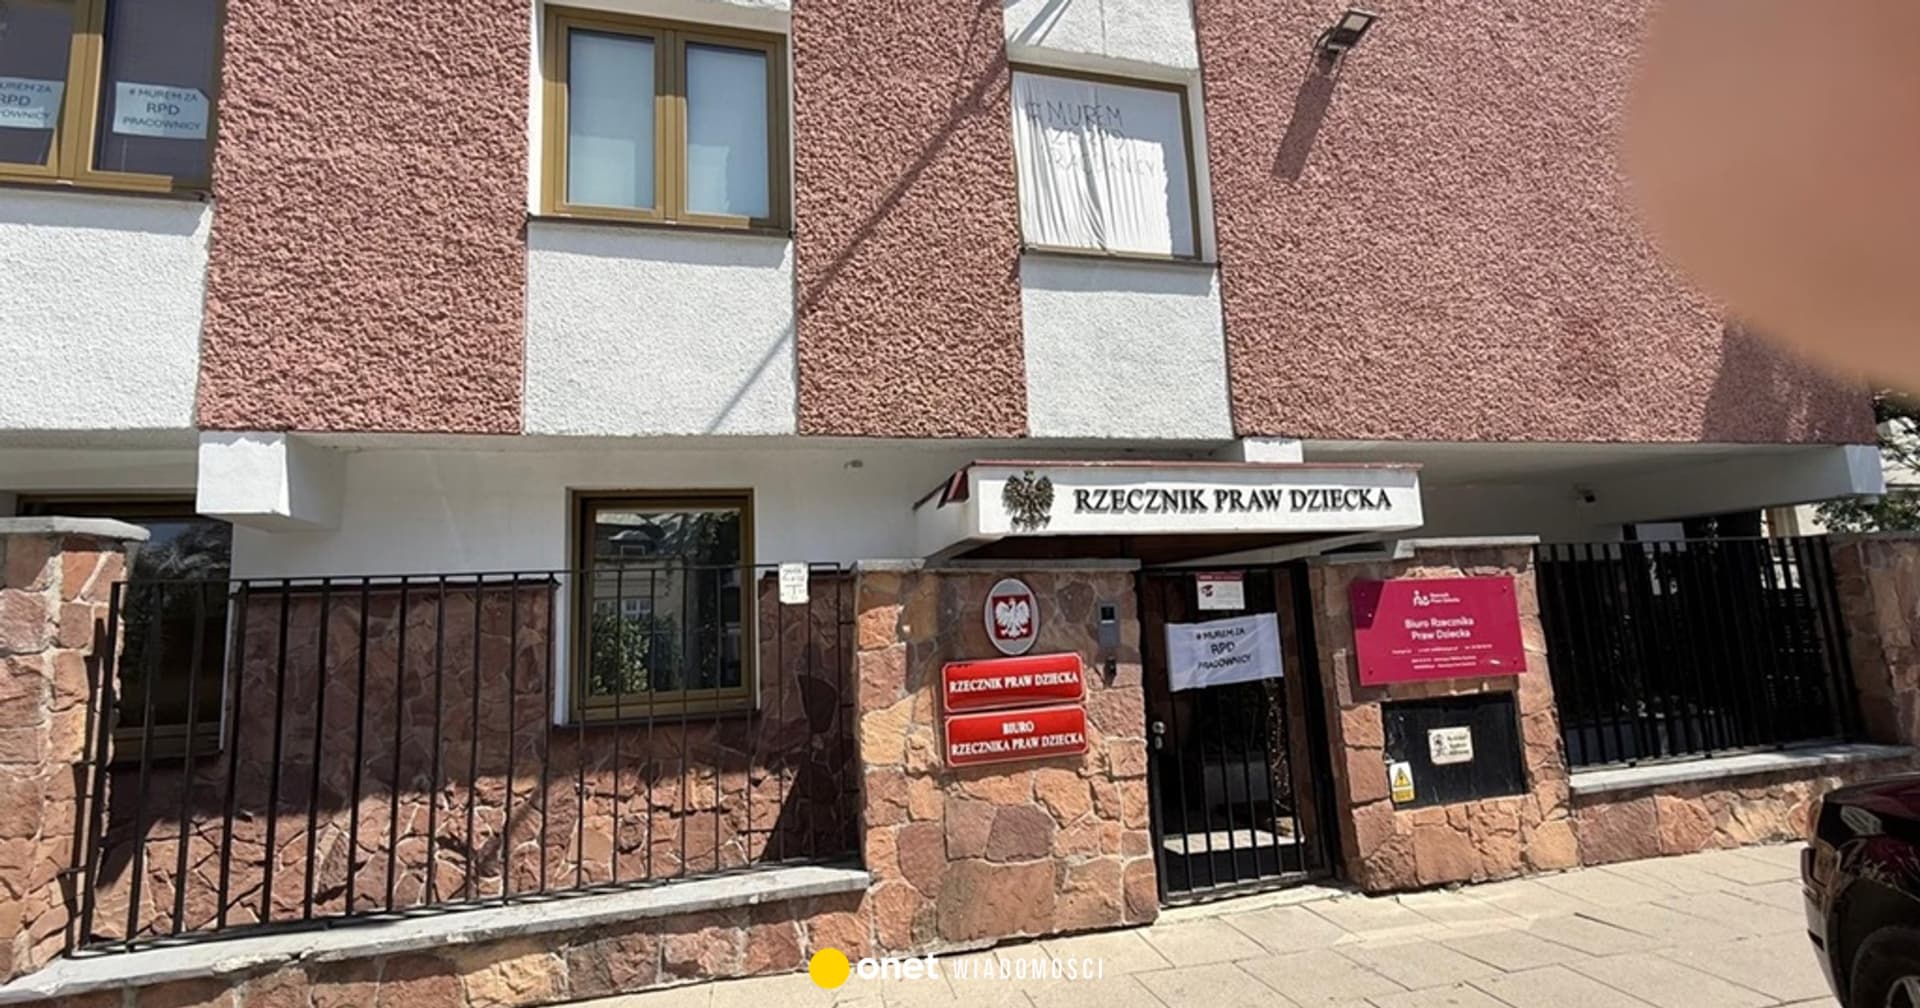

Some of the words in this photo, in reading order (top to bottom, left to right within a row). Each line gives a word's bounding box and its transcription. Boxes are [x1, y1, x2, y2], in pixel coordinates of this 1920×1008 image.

[0, 82, 34, 91] UREM
[138, 88, 183, 101] MUREM
[184, 92, 199, 102] ZA
[0, 109, 50, 120] OWNICY
[146, 102, 180, 116] RPD
[1046, 100, 1125, 128] MUREM
[122, 115, 201, 131] PRACOWNICY
[1073, 488, 1207, 514] RZECZNIK
[1213, 488, 1283, 512] PRAW
[1288, 488, 1393, 512] DZIECKA
[1404, 618, 1430, 629] Biuro
[1431, 616, 1475, 628] Rzecznika
[1411, 630, 1435, 641] Praw
[1436, 628, 1472, 640] Dziecka
[1210, 641, 1236, 655] RPD
[949, 677, 1003, 694] RZECZNIK
[1004, 674, 1034, 689] PRAW
[1034, 671, 1079, 686] DZIECKA
[1002, 720, 1035, 735] BIURO
[951, 739, 1011, 756] RZECZNIKA
[1012, 735, 1041, 750] PRAW
[1041, 732, 1085, 747] DZIECKA
